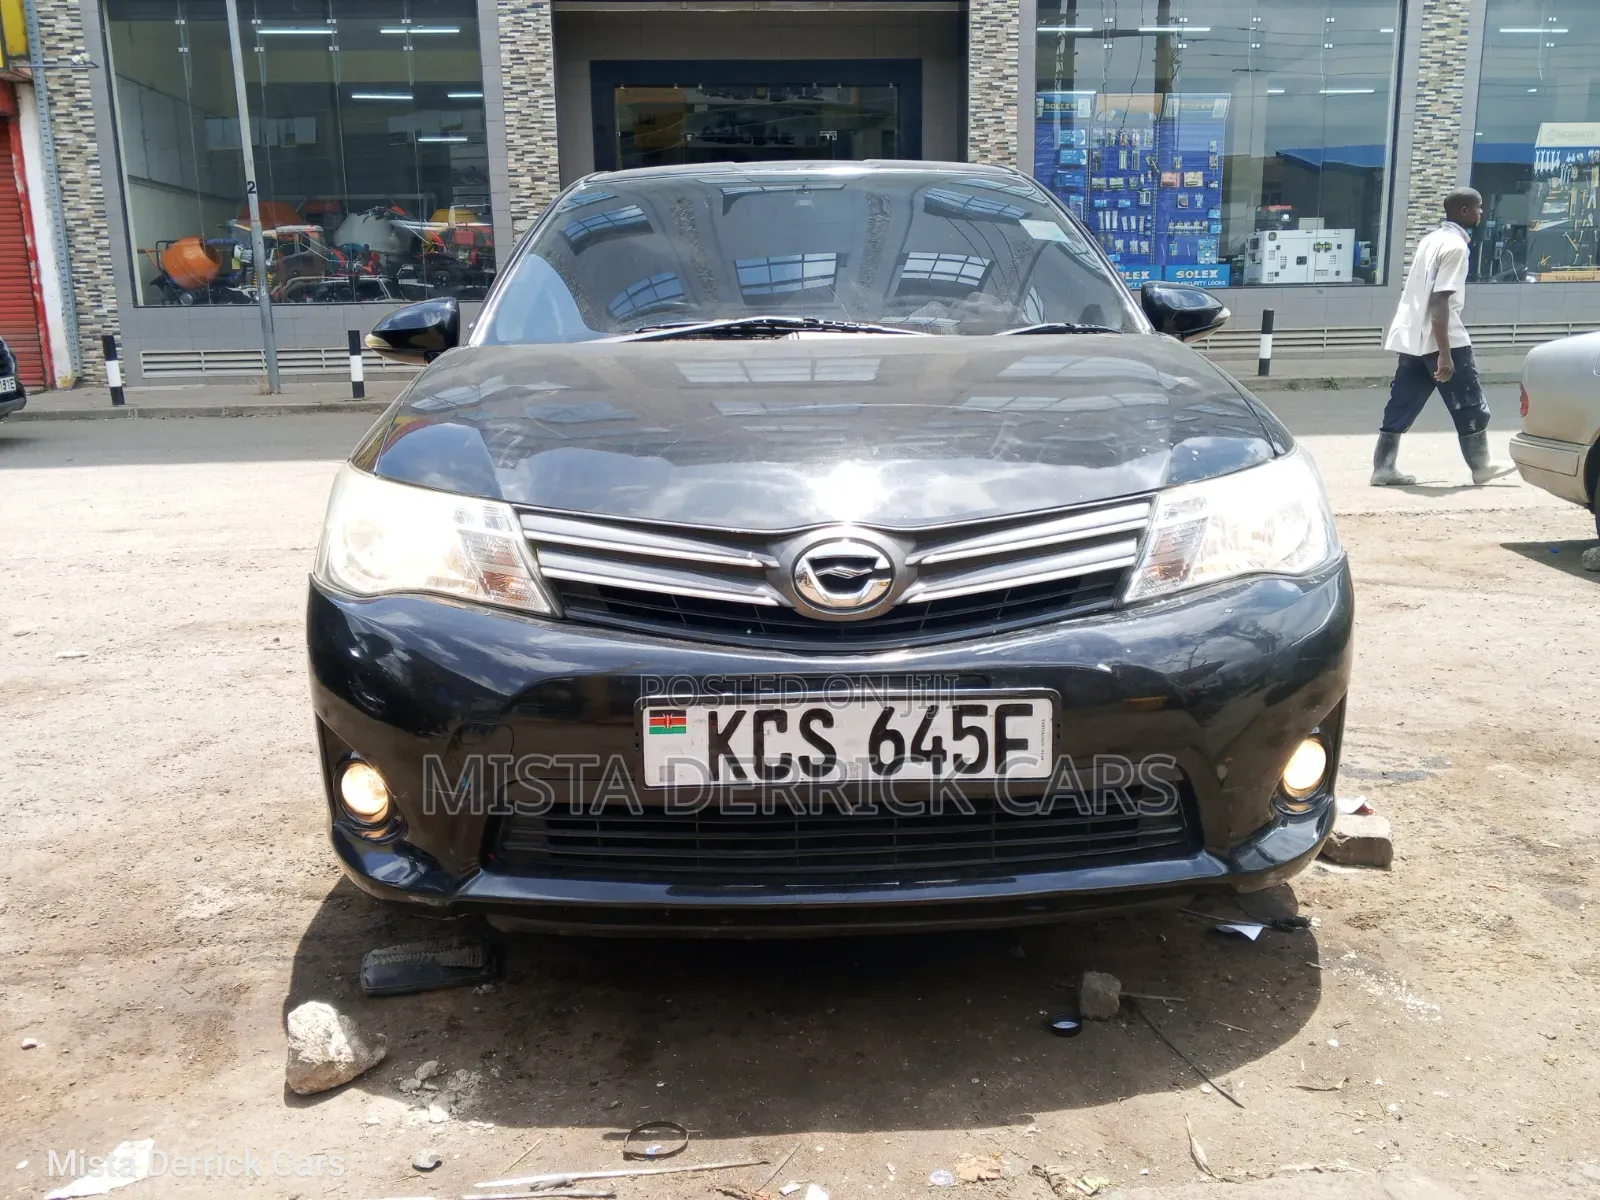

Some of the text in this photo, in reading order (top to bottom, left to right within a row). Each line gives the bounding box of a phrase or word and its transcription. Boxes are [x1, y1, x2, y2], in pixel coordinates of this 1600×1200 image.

[247, 180, 257, 195] 2
[1175, 269, 1219, 279] SOLEX
[708, 703, 1034, 781] KCS 645F
